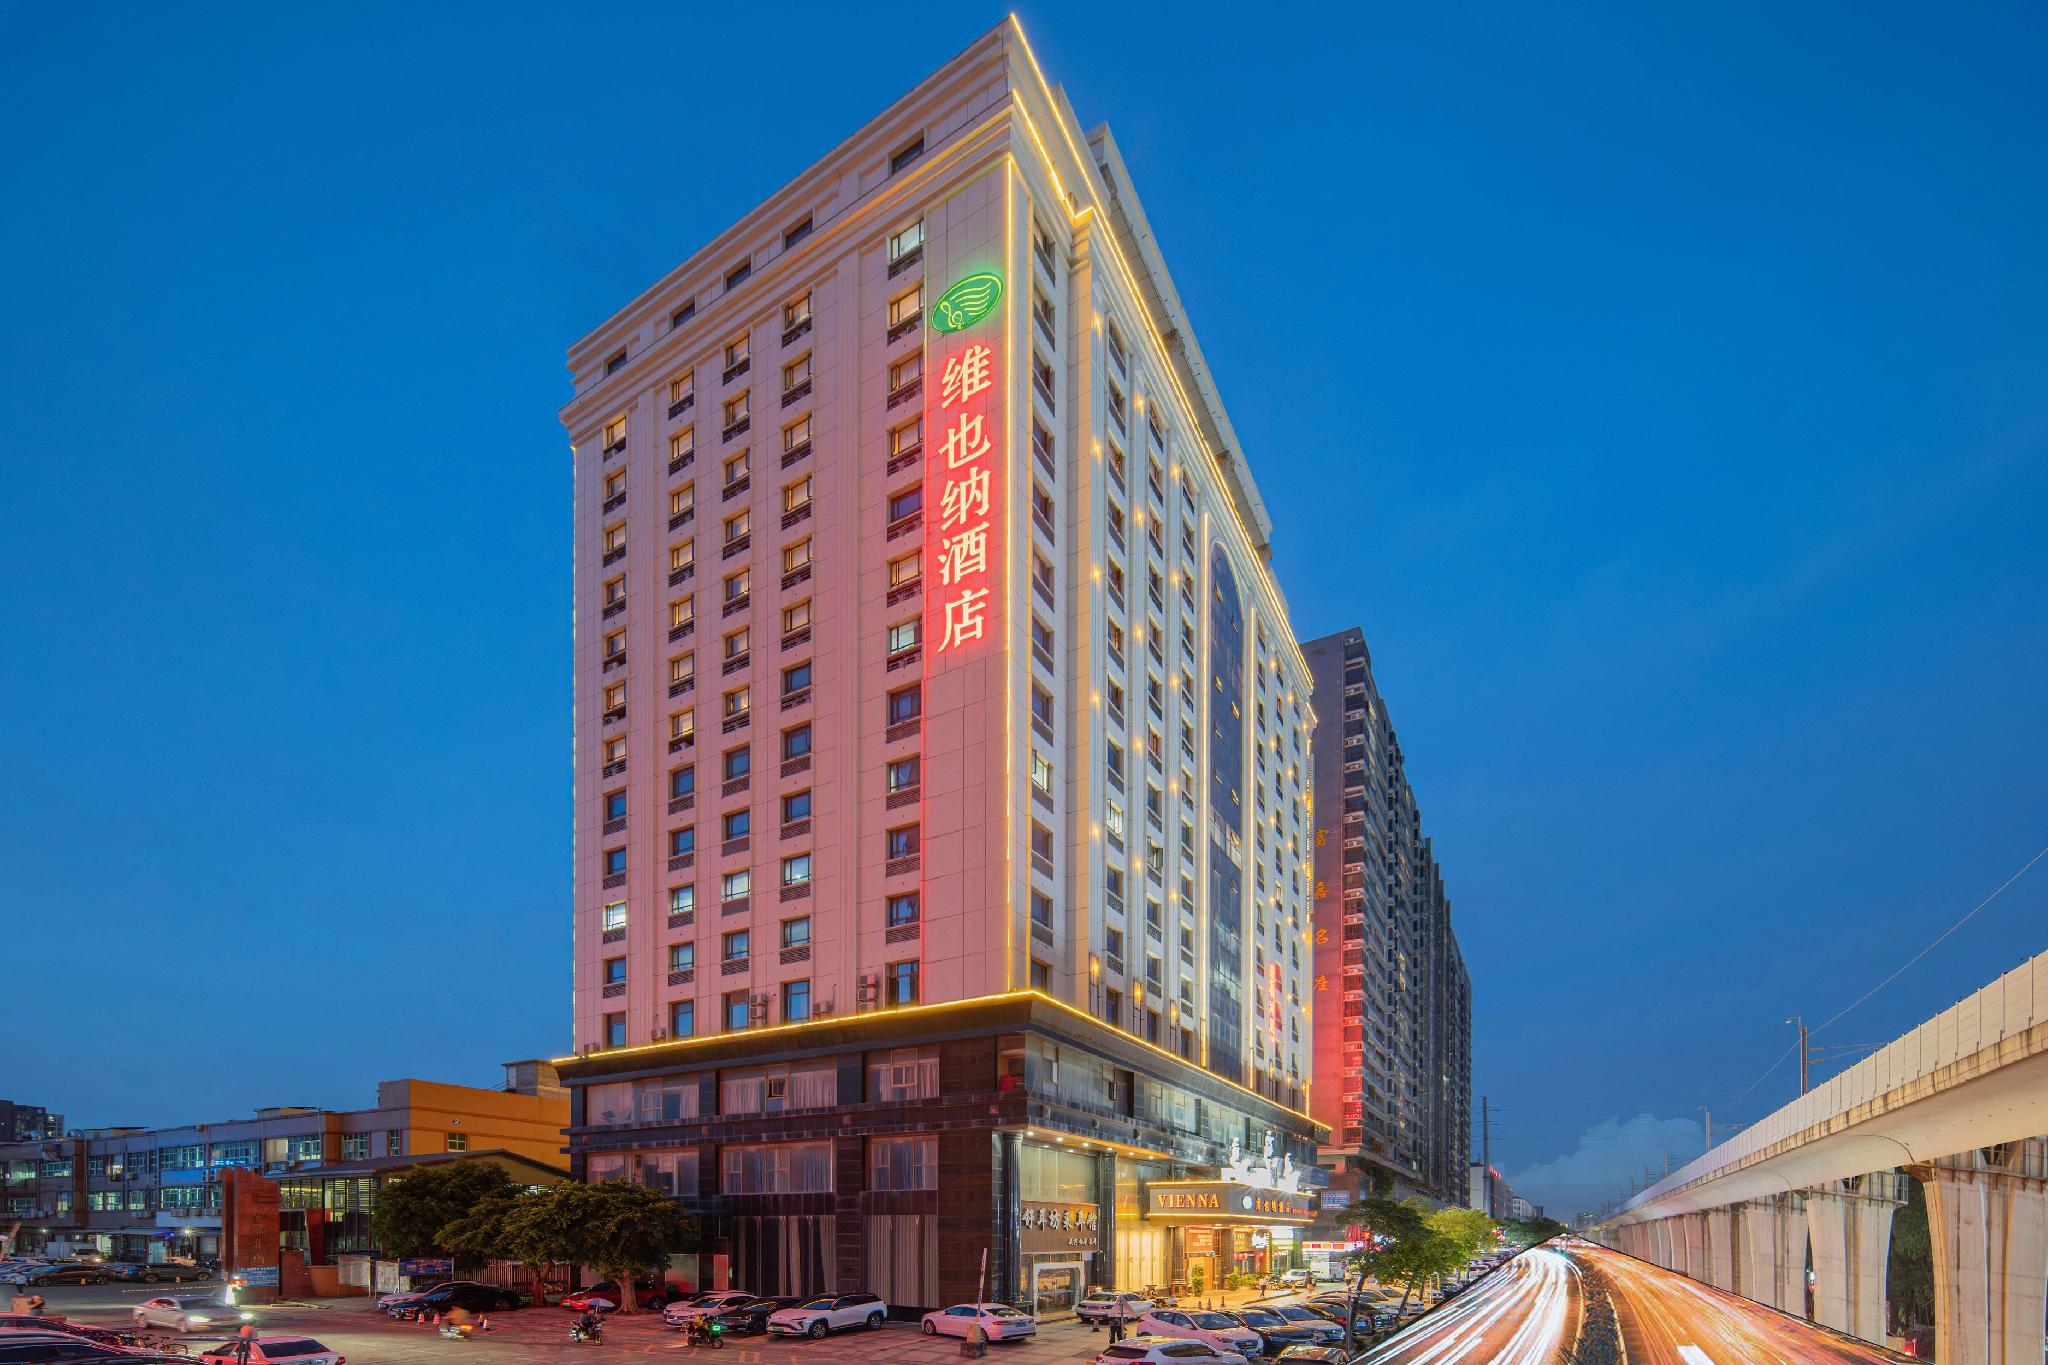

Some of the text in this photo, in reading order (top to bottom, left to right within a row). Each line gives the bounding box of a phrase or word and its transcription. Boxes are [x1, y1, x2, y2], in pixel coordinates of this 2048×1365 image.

[938, 344, 992, 653] 维也纳酒店
[1157, 1193, 1220, 1208] VIENNA
